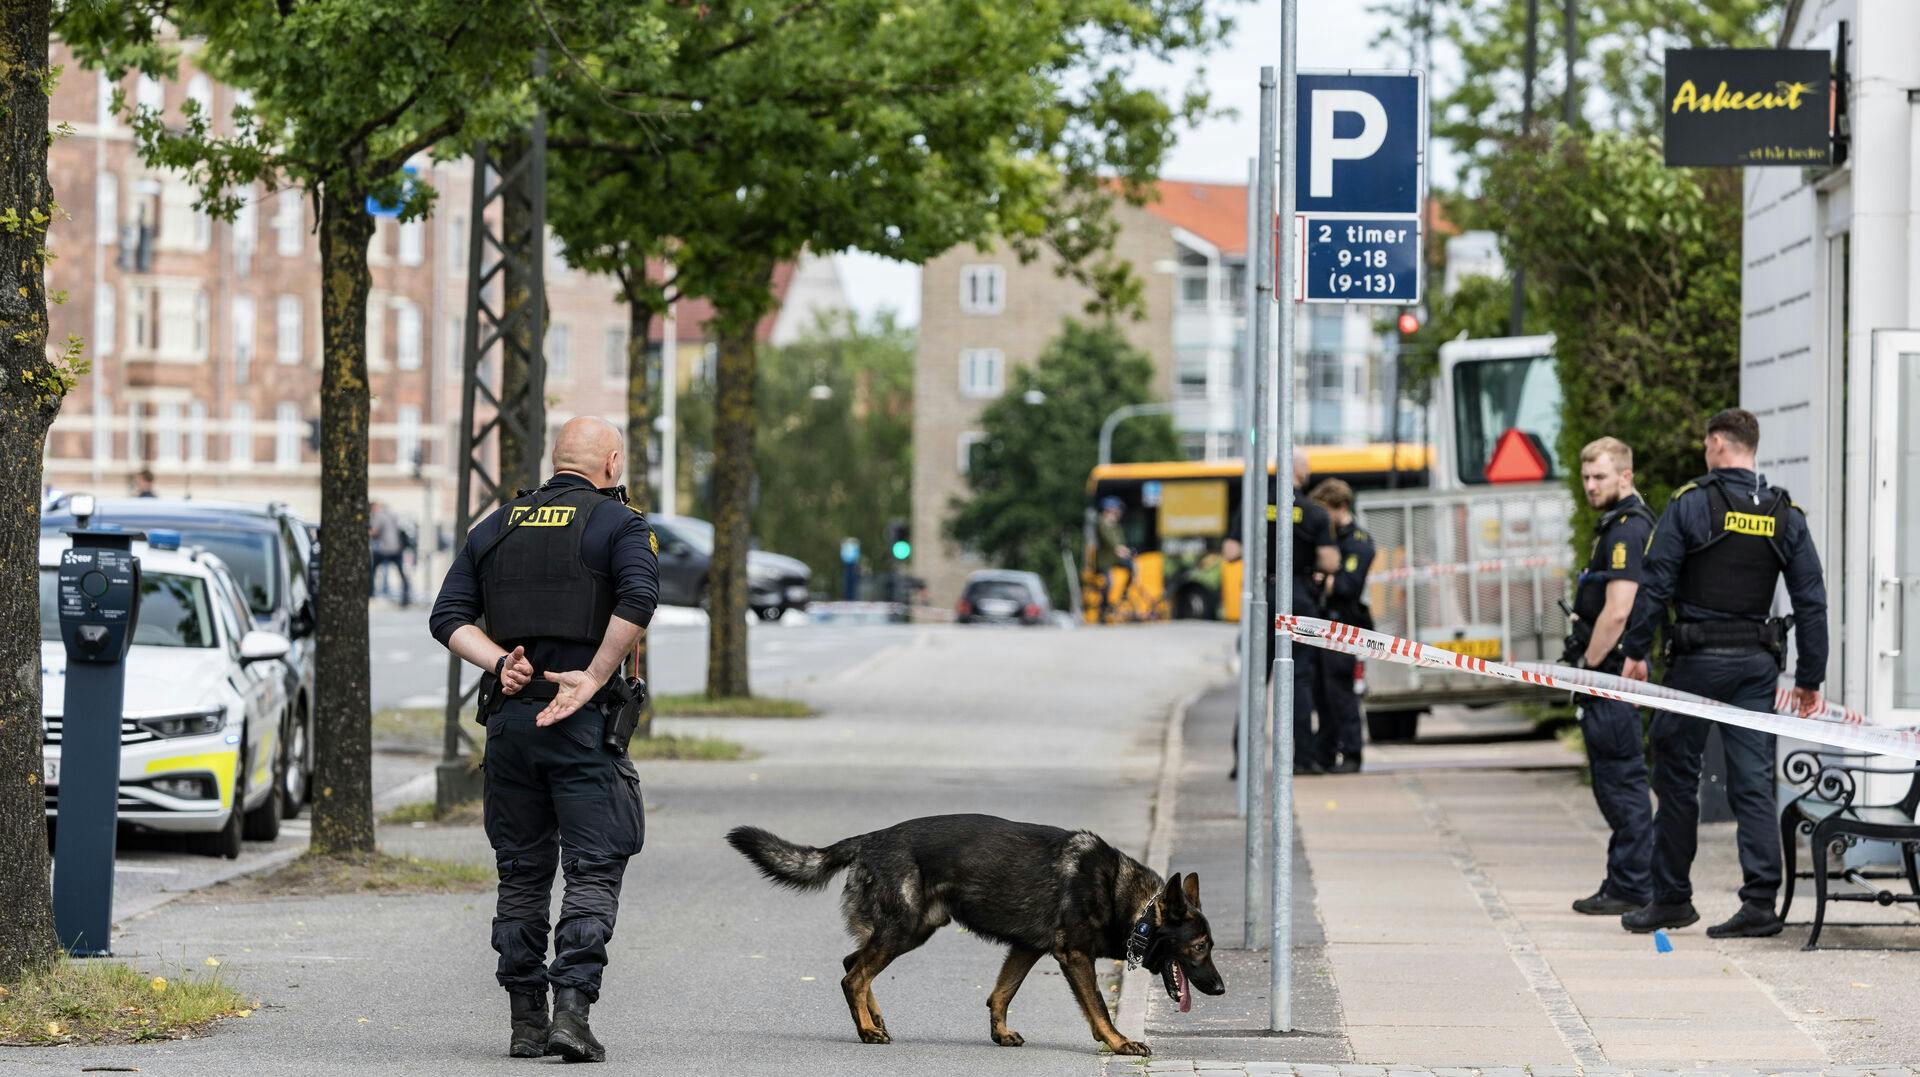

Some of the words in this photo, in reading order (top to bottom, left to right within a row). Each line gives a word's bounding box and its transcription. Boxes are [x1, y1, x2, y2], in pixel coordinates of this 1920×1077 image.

[1310, 89, 1388, 197] P
[1319, 224, 1332, 243] 2
[1346, 225, 1408, 244] timer
[1337, 249, 1388, 269] 9-18
[1329, 272, 1396, 294] (9-13)
[1727, 516, 1772, 532] POLITI
